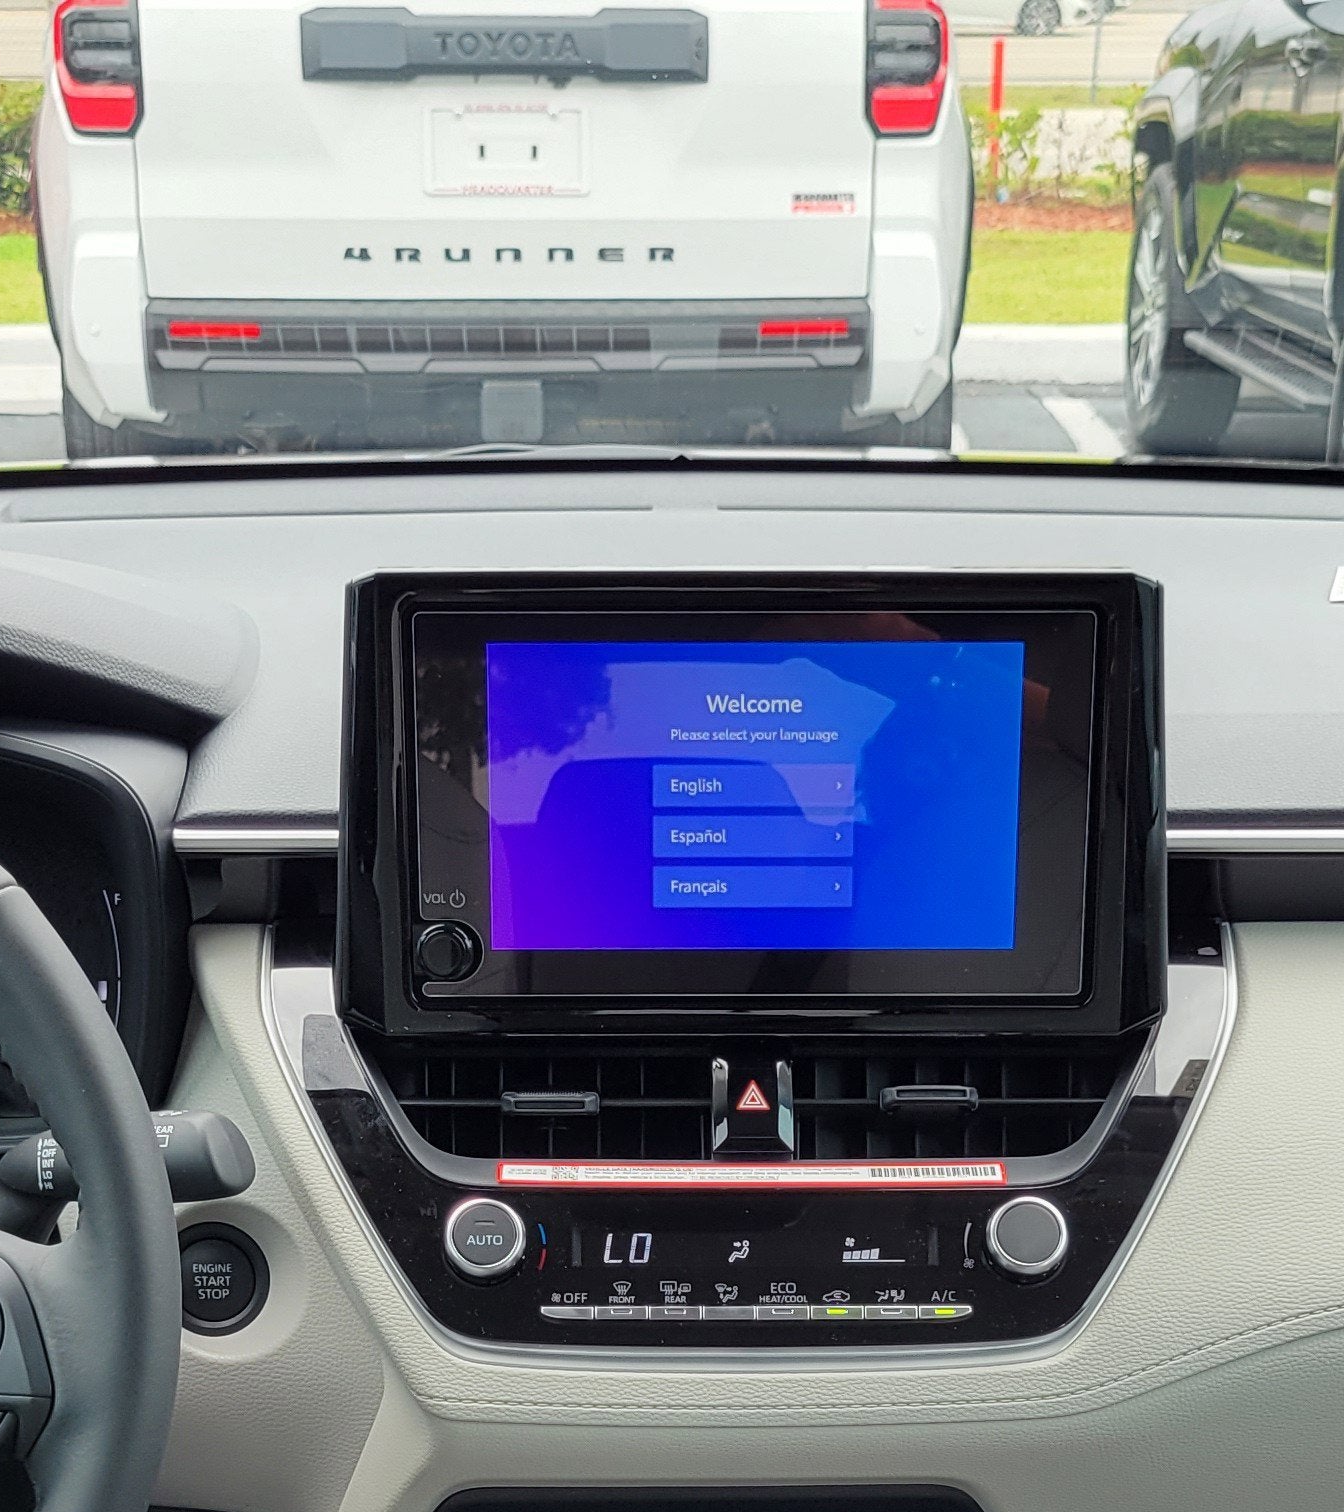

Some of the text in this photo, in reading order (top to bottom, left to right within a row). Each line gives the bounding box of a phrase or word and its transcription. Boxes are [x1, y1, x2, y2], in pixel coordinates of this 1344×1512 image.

[432, 30, 580, 61] TOYOTA
[343, 246, 677, 263] 4RUNNER
[706, 693, 803, 714] Welcome
[670, 728, 838, 744] Please select your language
[670, 777, 722, 797] English
[670, 828, 727, 847] Español
[670, 878, 728, 898] Français
[114, 894, 121, 906] F
[423, 893, 446, 905] VOL
[155, 1126, 174, 1134] EAR
[42, 1149, 56, 1157] OFF
[42, 1159, 54, 1168] INT
[43, 1170, 53, 1180] LO
[466, 1234, 503, 1246] AUTO
[603, 1232, 653, 1264] LO
[192, 1263, 233, 1274] ENGINE
[194, 1275, 231, 1288] START
[197, 1288, 230, 1300] STOP
[770, 1282, 797, 1294] ECO
[563, 1293, 588, 1304] OFF
[759, 1295, 808, 1304] HEAT/COOL
[931, 1290, 957, 1302] A/C
